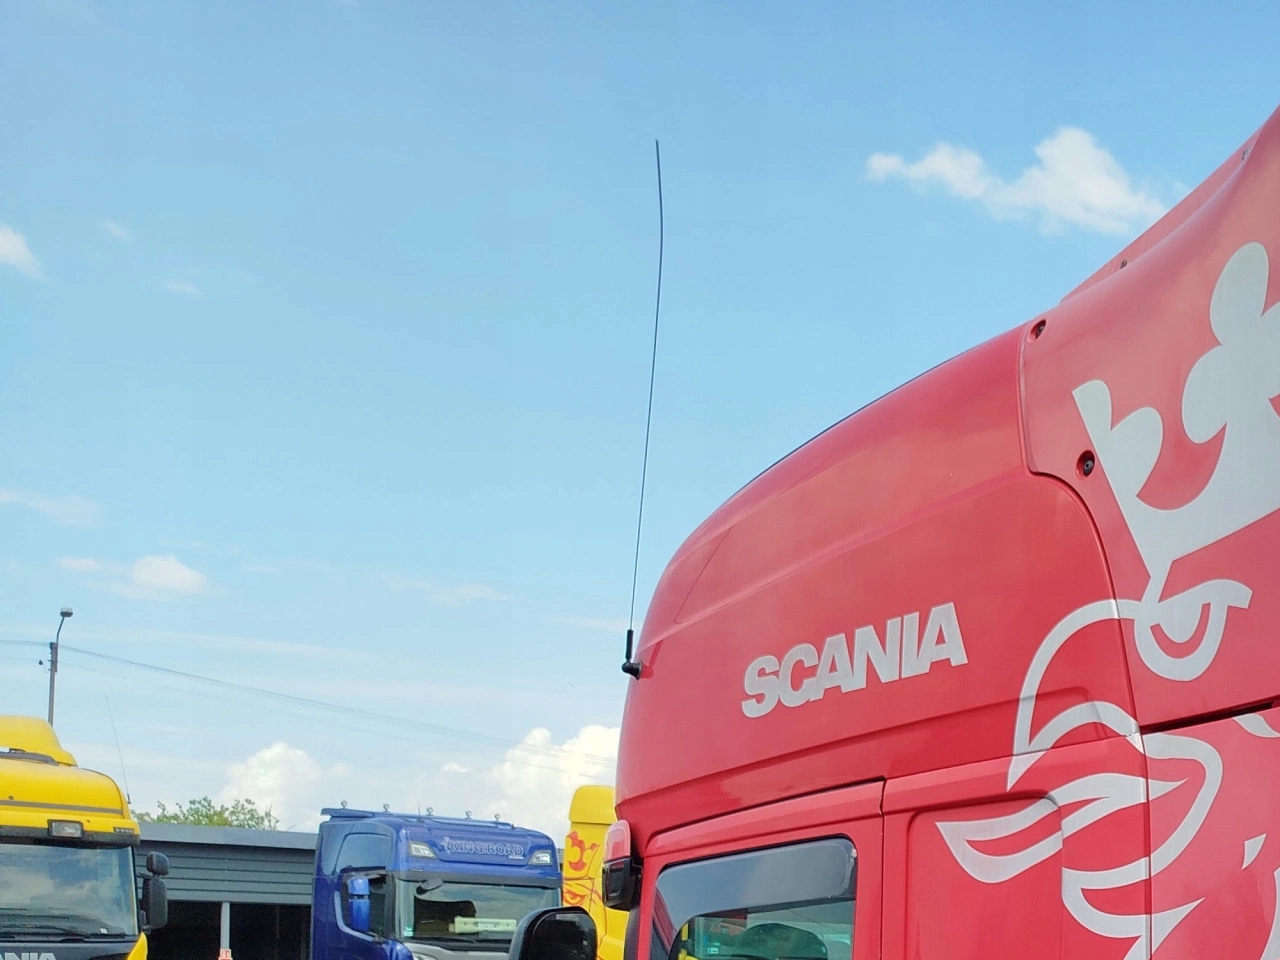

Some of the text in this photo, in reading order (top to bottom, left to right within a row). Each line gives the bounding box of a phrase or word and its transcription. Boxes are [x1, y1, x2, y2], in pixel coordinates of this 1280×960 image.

[741, 601, 969, 719] SCANIA
[450, 840, 524, 857] KING ROAD
